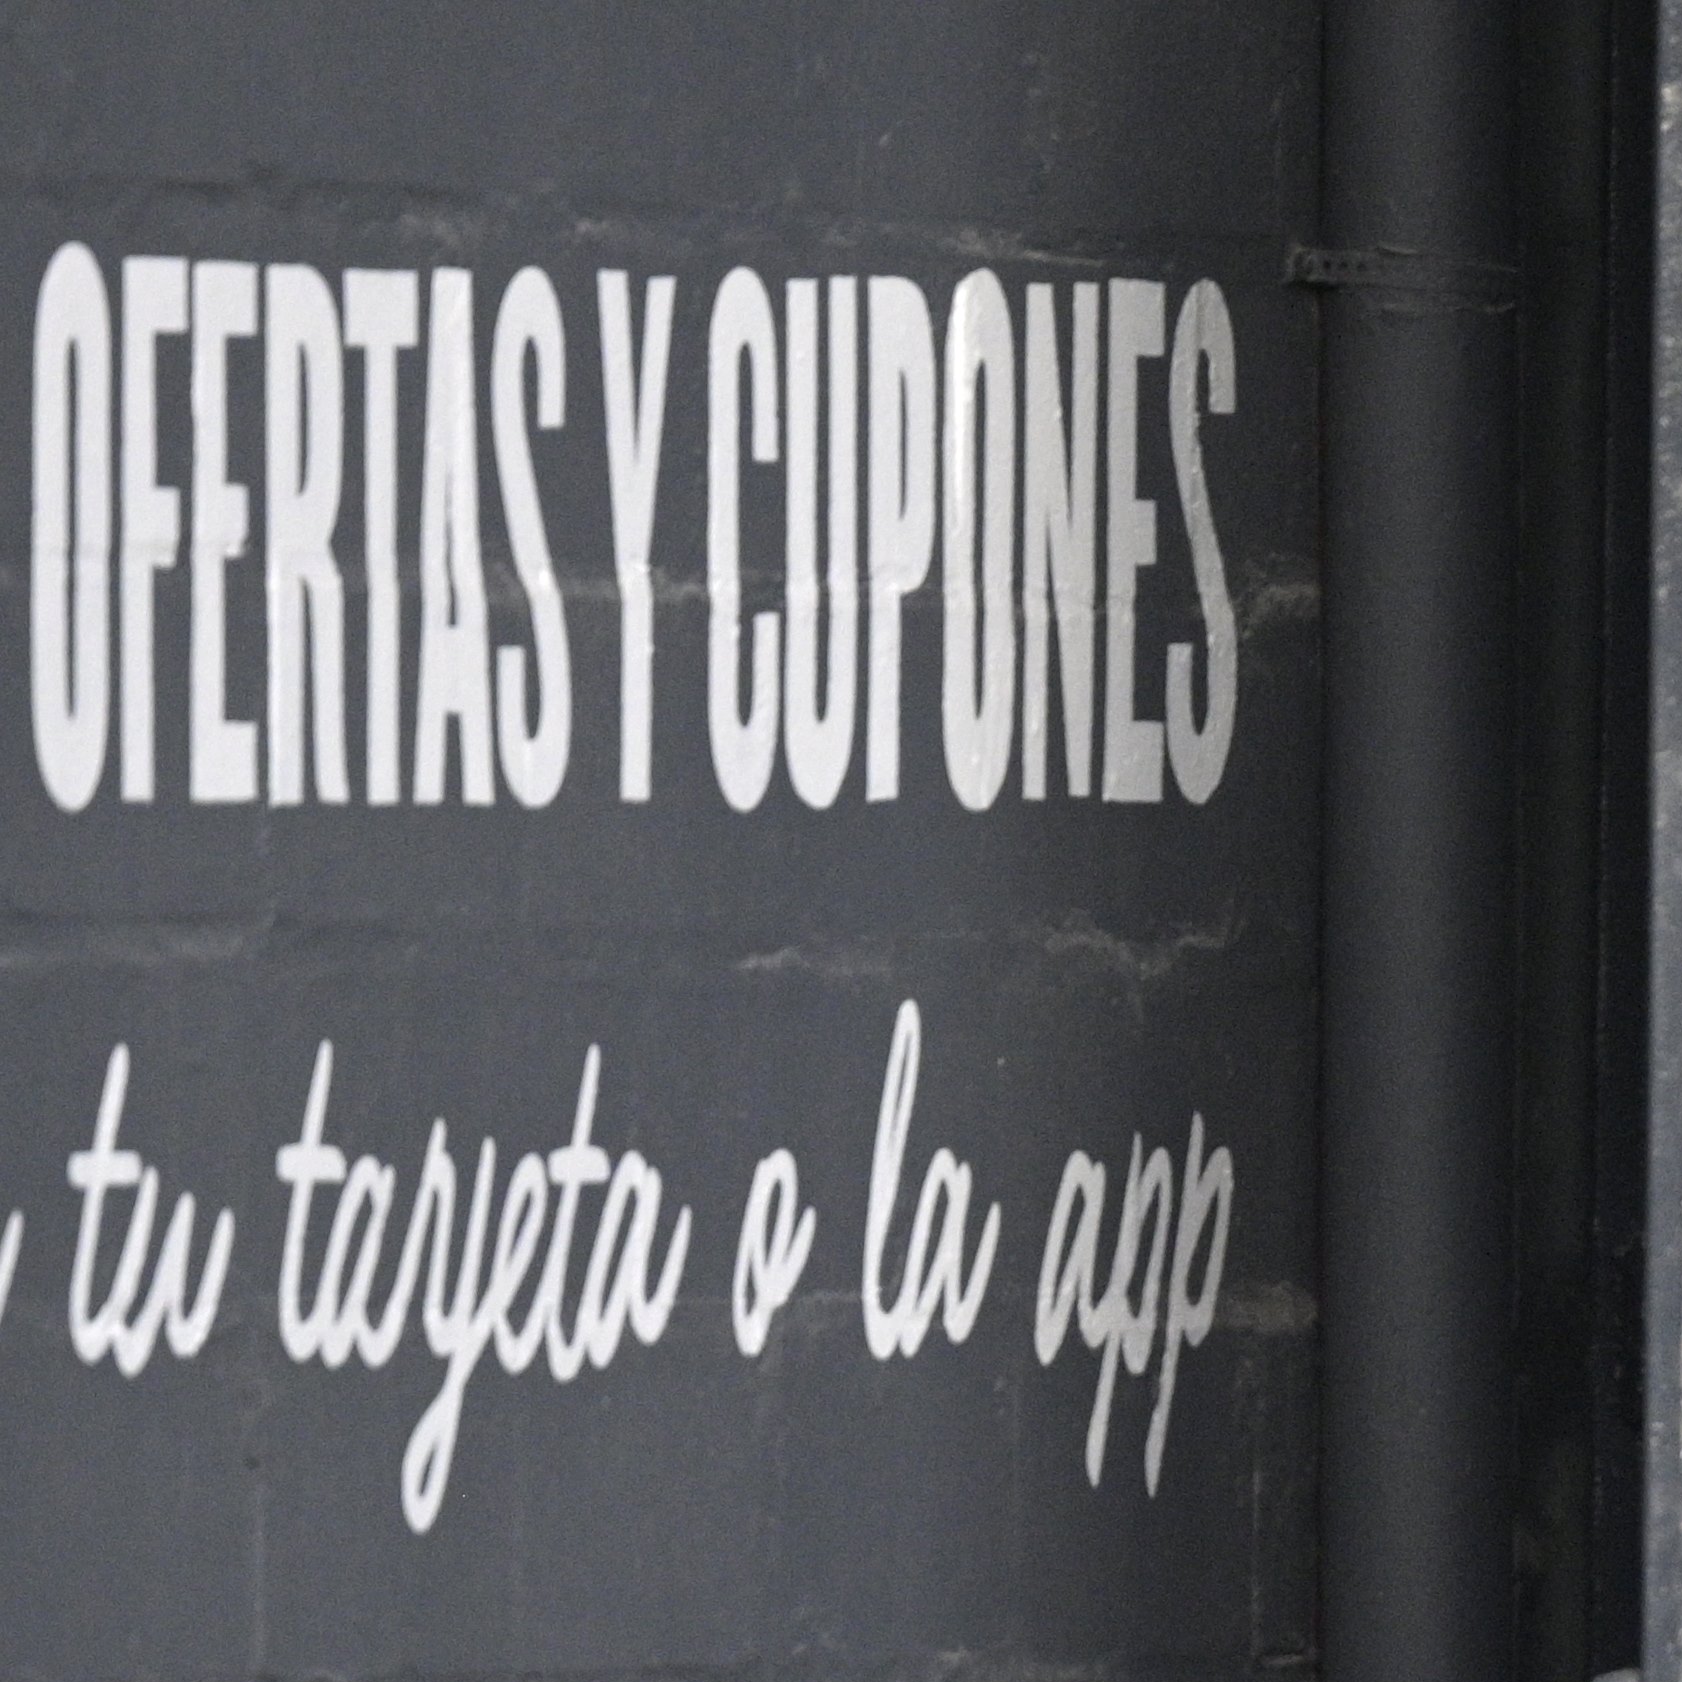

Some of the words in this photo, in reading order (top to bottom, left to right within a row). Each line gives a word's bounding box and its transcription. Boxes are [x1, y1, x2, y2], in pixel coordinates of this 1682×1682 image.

[30, 241, 573, 814] OFERTAS
[596, 268, 677, 804] Y
[706, 266, 1236, 814] CUPONES
[66, 1042, 236, 1379] tu
[275, 1038, 692, 1535] tarjeta
[731, 1148, 817, 1358] o
[860, 998, 1001, 1361] la
[1034, 1115, 1232, 1495] app
